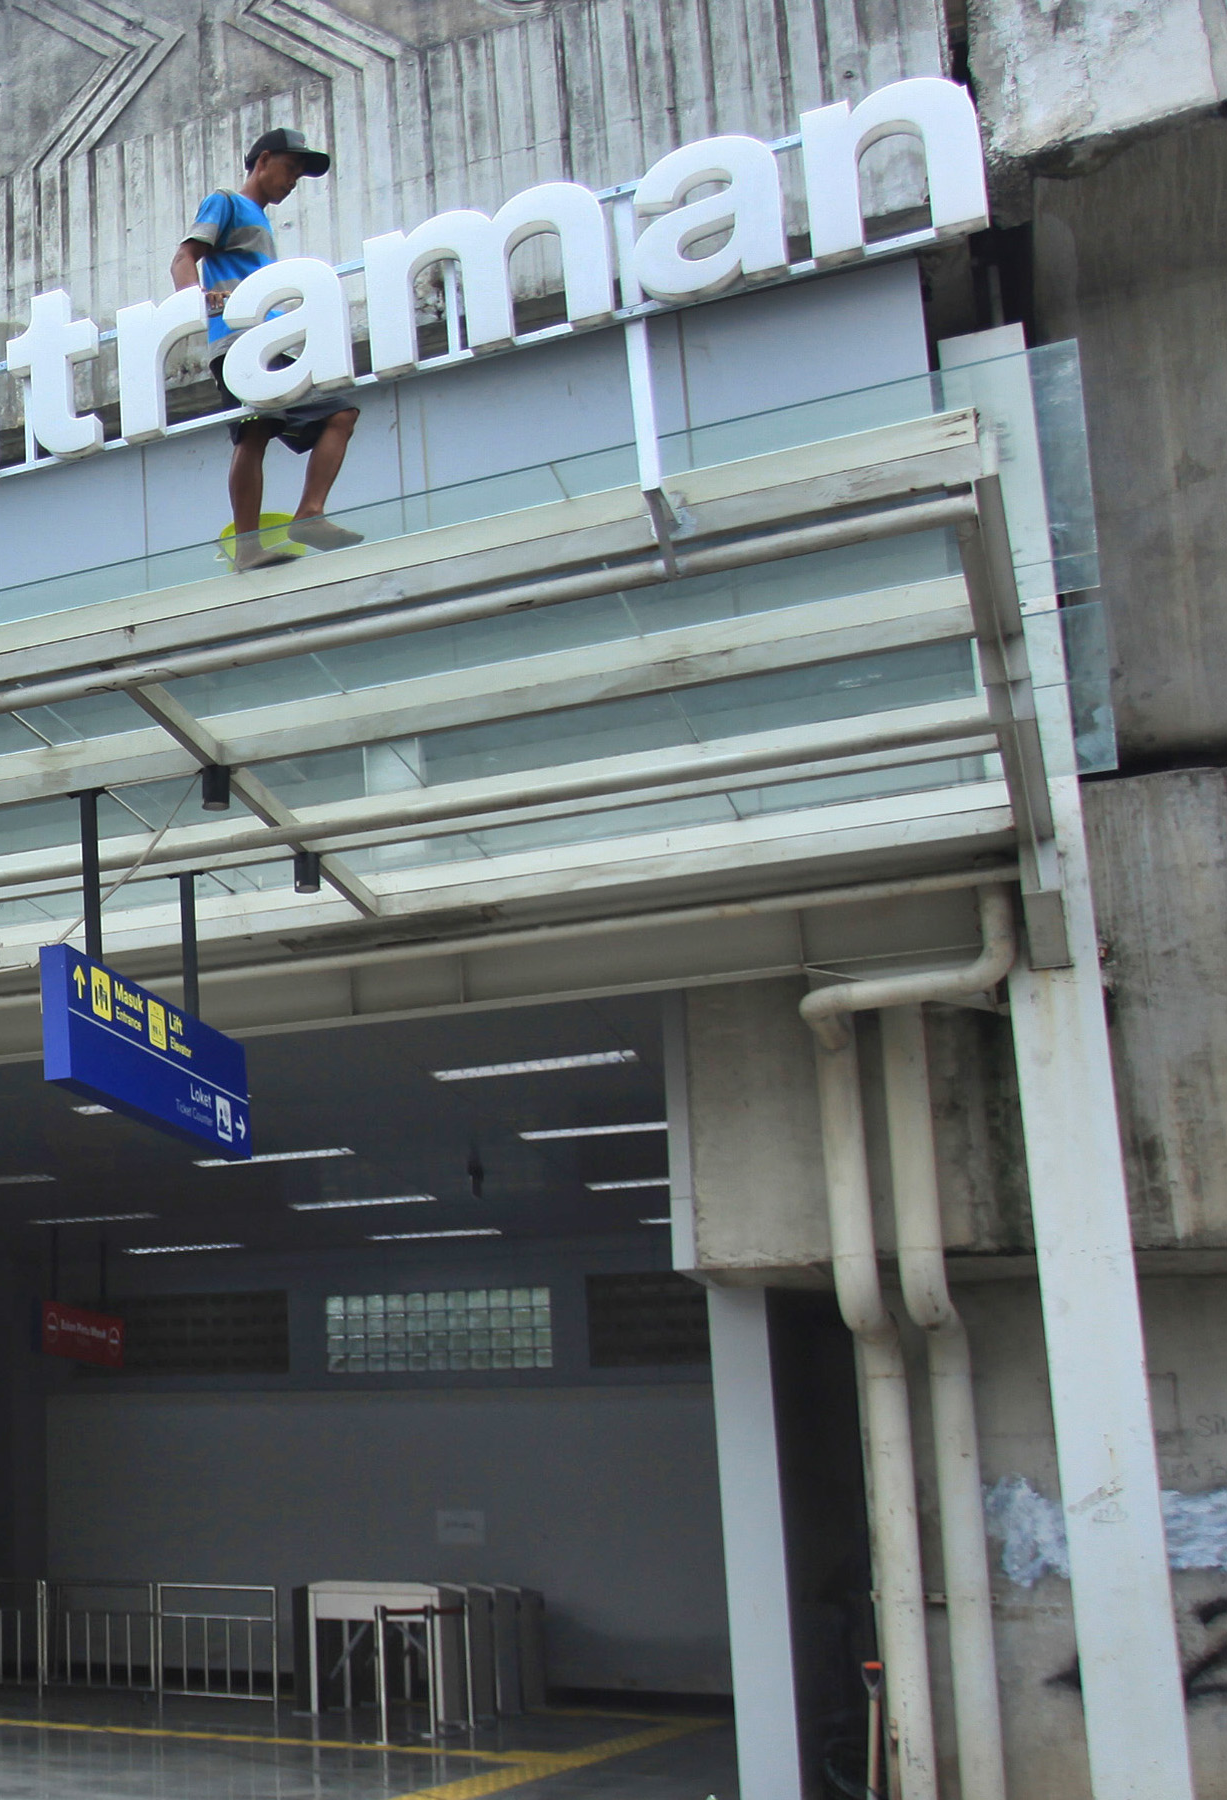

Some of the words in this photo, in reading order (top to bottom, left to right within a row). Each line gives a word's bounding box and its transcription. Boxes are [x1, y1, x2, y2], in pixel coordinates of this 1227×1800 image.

[114, 980, 144, 1014] Masuk
[115, 1005, 142, 1031] Entrance
[168, 1011, 183, 1036] Lift
[169, 1035, 192, 1058] Elevator
[189, 1082, 212, 1109] Loket
